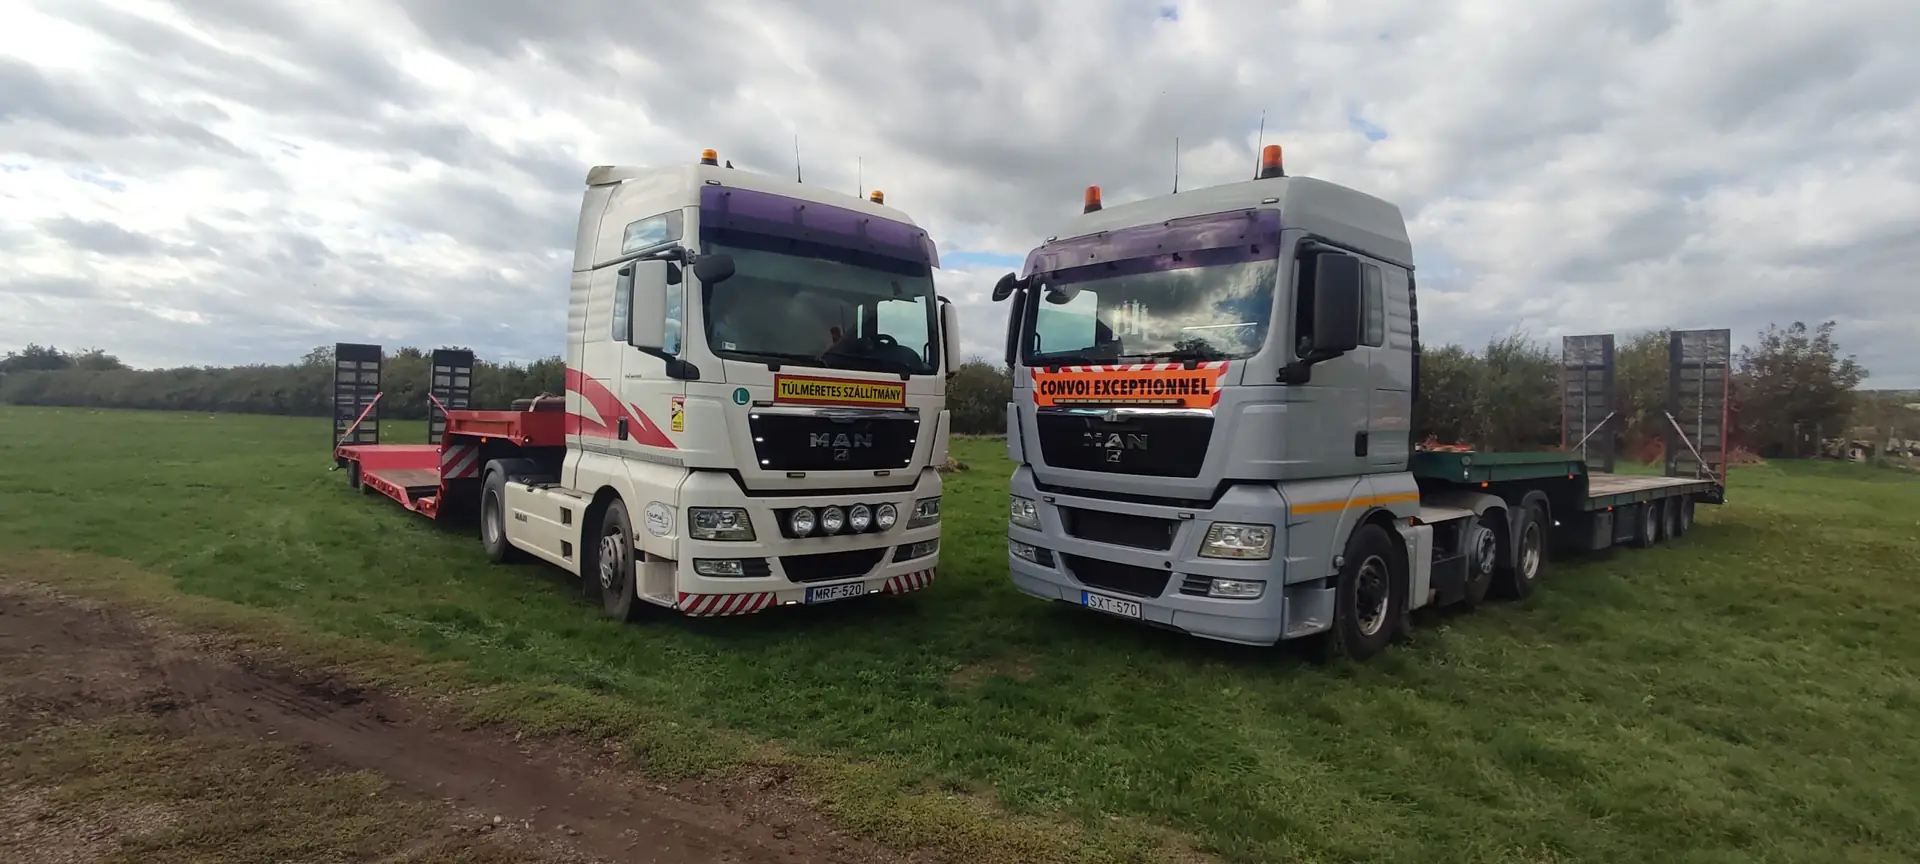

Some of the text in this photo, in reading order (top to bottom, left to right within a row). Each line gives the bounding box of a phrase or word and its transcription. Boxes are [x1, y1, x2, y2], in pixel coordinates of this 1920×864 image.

[781, 381, 901, 401] TÚLMÉRETES SZÁLLÍTMÁNY
[1040, 378, 1210, 396] CONVOI EXCEPTIONNEL
[737, 390, 746, 404] L
[810, 432, 873, 448] MAN
[815, 584, 862, 600] MRF-520
[1090, 595, 1138, 616] SXT-570
